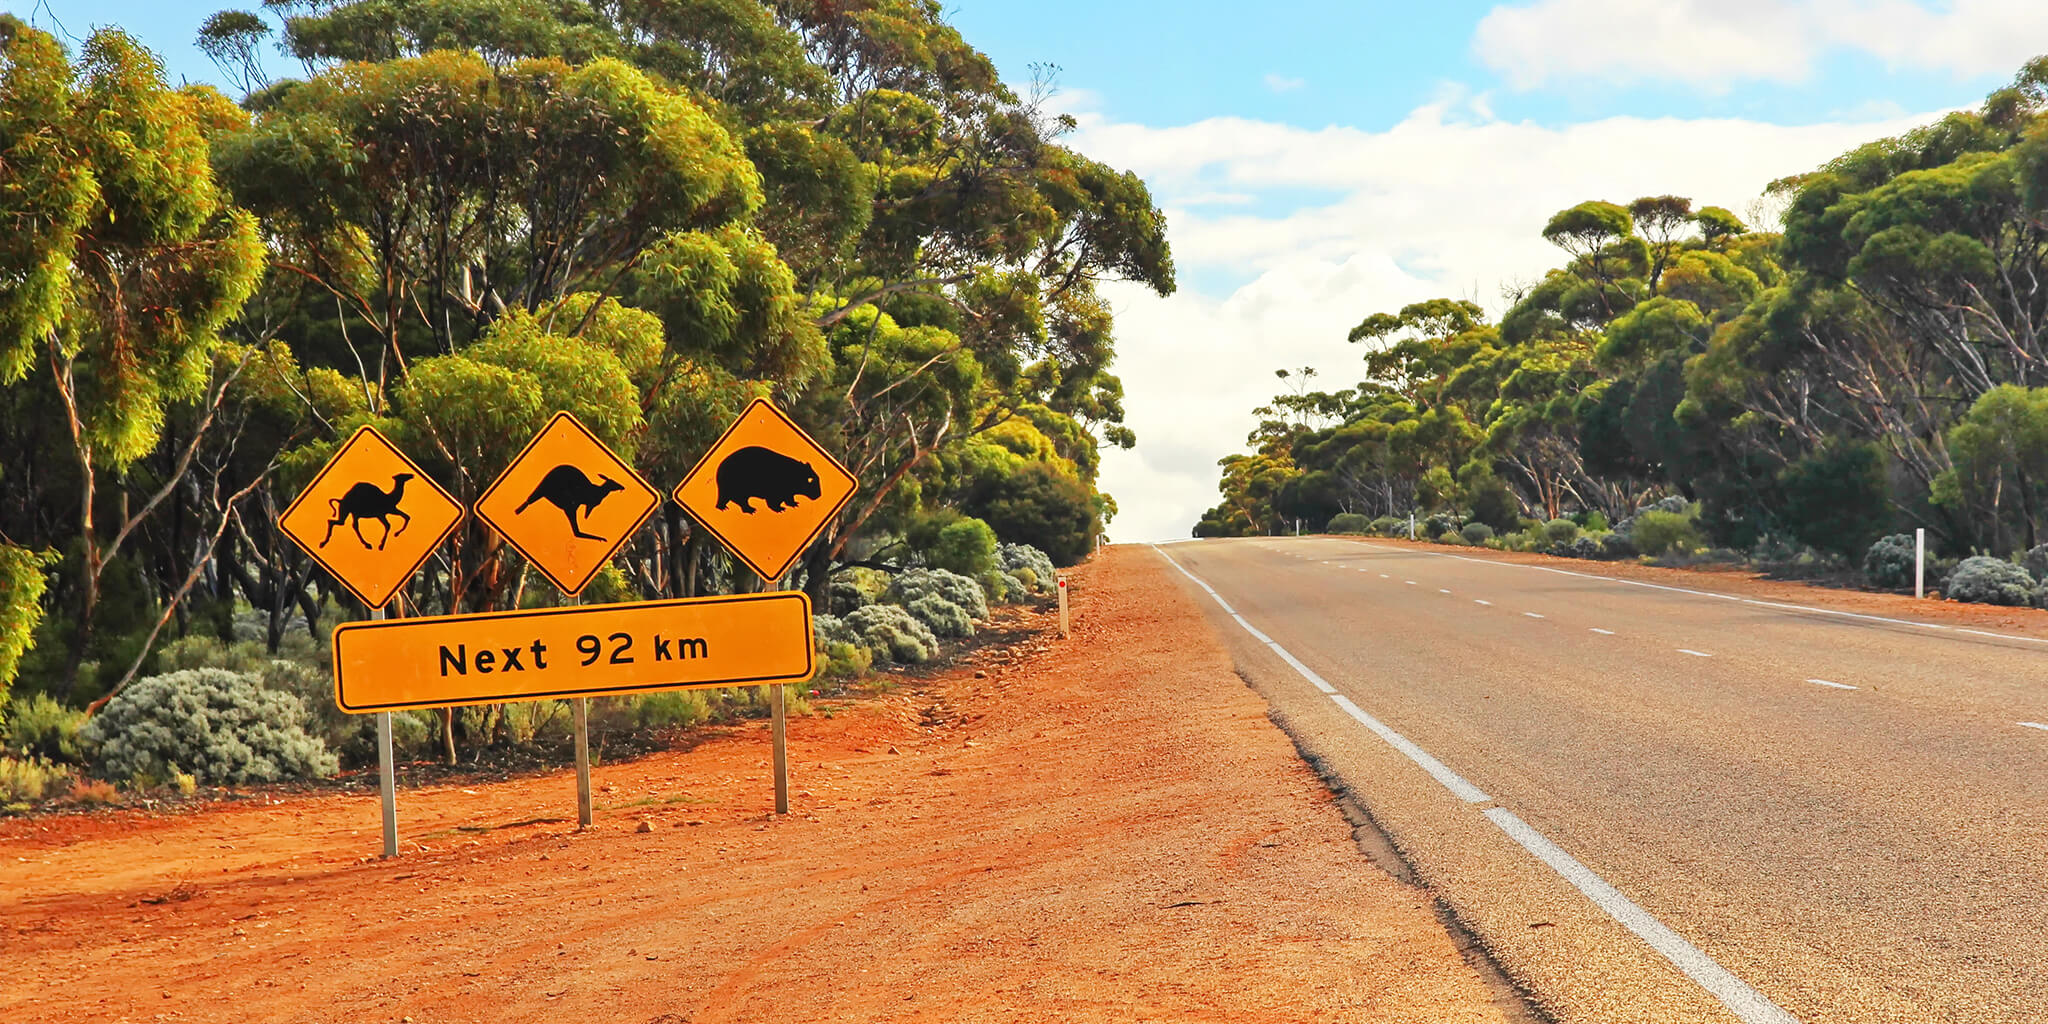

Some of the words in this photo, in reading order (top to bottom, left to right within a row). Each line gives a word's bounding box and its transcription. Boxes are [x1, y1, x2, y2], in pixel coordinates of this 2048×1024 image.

[439, 638, 548, 677] Next
[576, 632, 635, 667] 92
[654, 634, 708, 662] km
